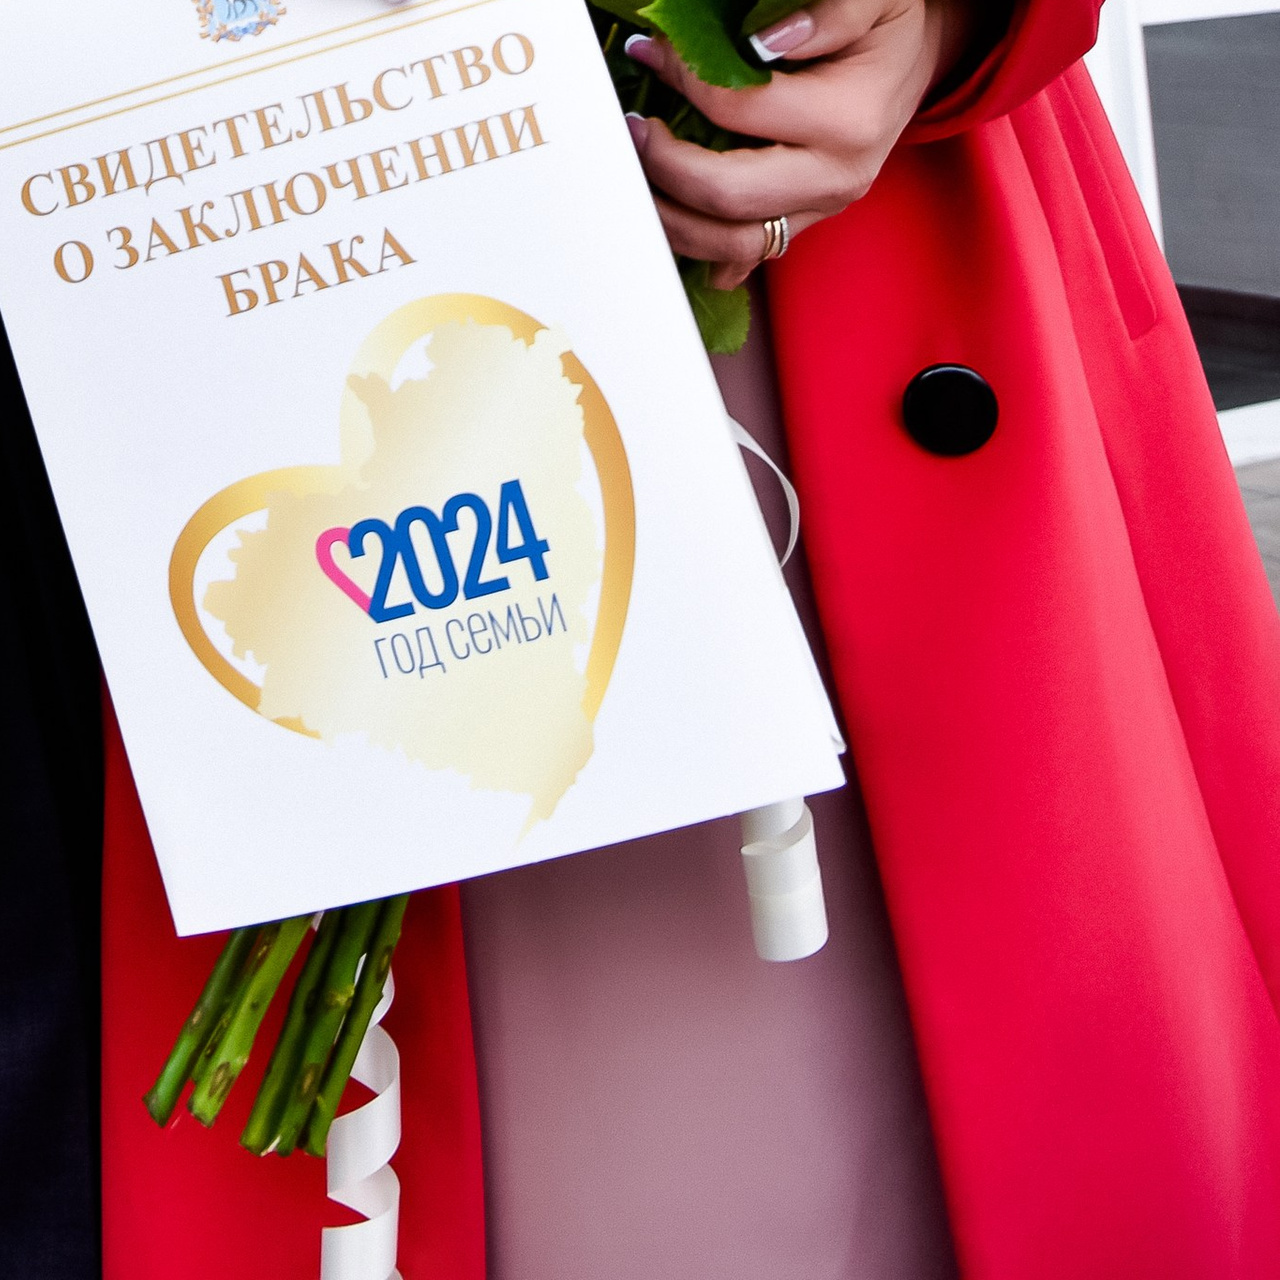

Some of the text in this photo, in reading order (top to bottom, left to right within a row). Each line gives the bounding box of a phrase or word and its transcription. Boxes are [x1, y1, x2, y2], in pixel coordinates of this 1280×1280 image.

[19, 31, 536, 217] СВИДЕТЕЛЬСТВО
[52, 102, 551, 284] О ЗАКЛЮЧЕНИИ
[214, 226, 418, 318] БРАКА
[347, 478, 551, 624] 2024
[373, 626, 447, 680] ГОД
